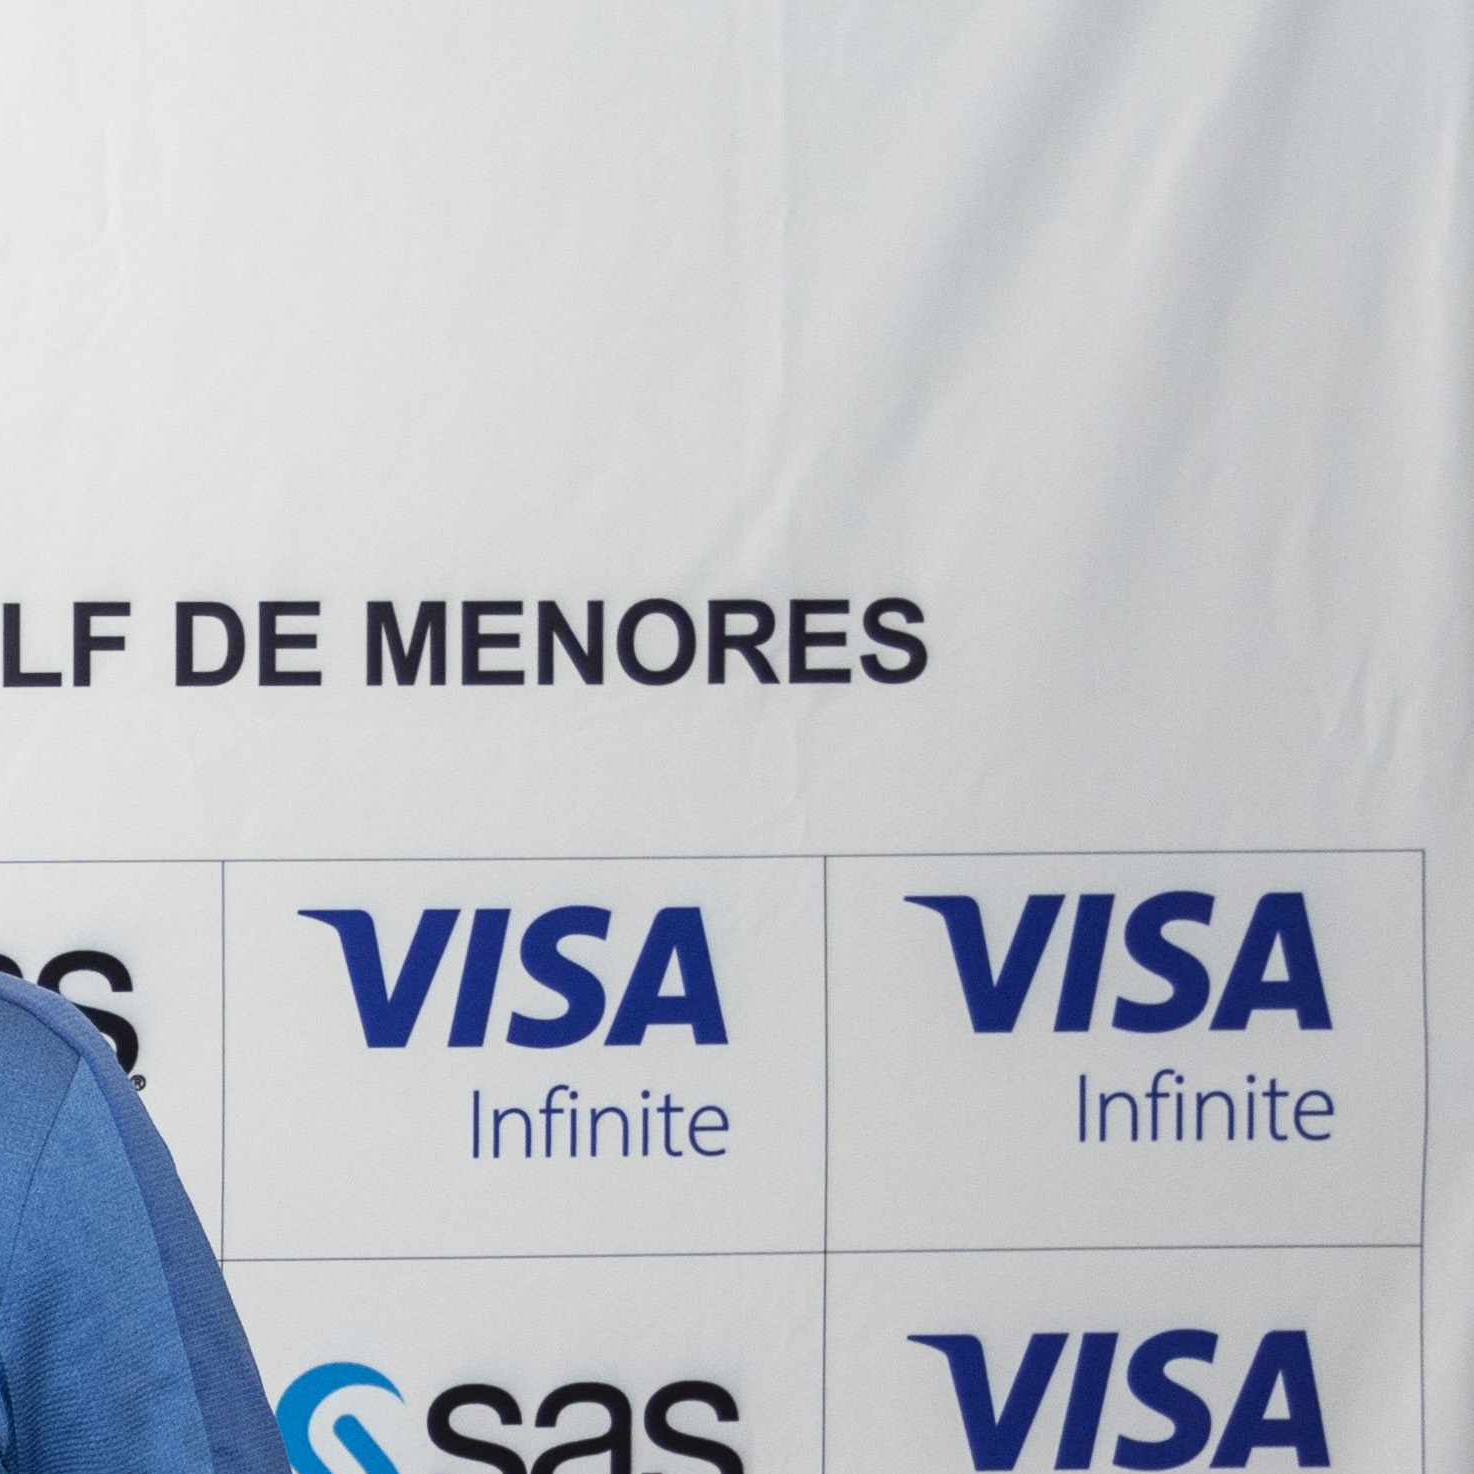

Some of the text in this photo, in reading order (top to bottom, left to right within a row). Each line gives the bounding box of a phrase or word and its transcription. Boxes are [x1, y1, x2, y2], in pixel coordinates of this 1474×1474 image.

[175, 600, 323, 687] DE
[366, 596, 929, 686] MENORES
[297, 904, 729, 1049] VISA
[904, 890, 1333, 1034] VISA
[473, 1084, 730, 1159] Infinite
[1079, 1068, 1335, 1142] Infinite
[907, 1328, 1331, 1472] VISA
